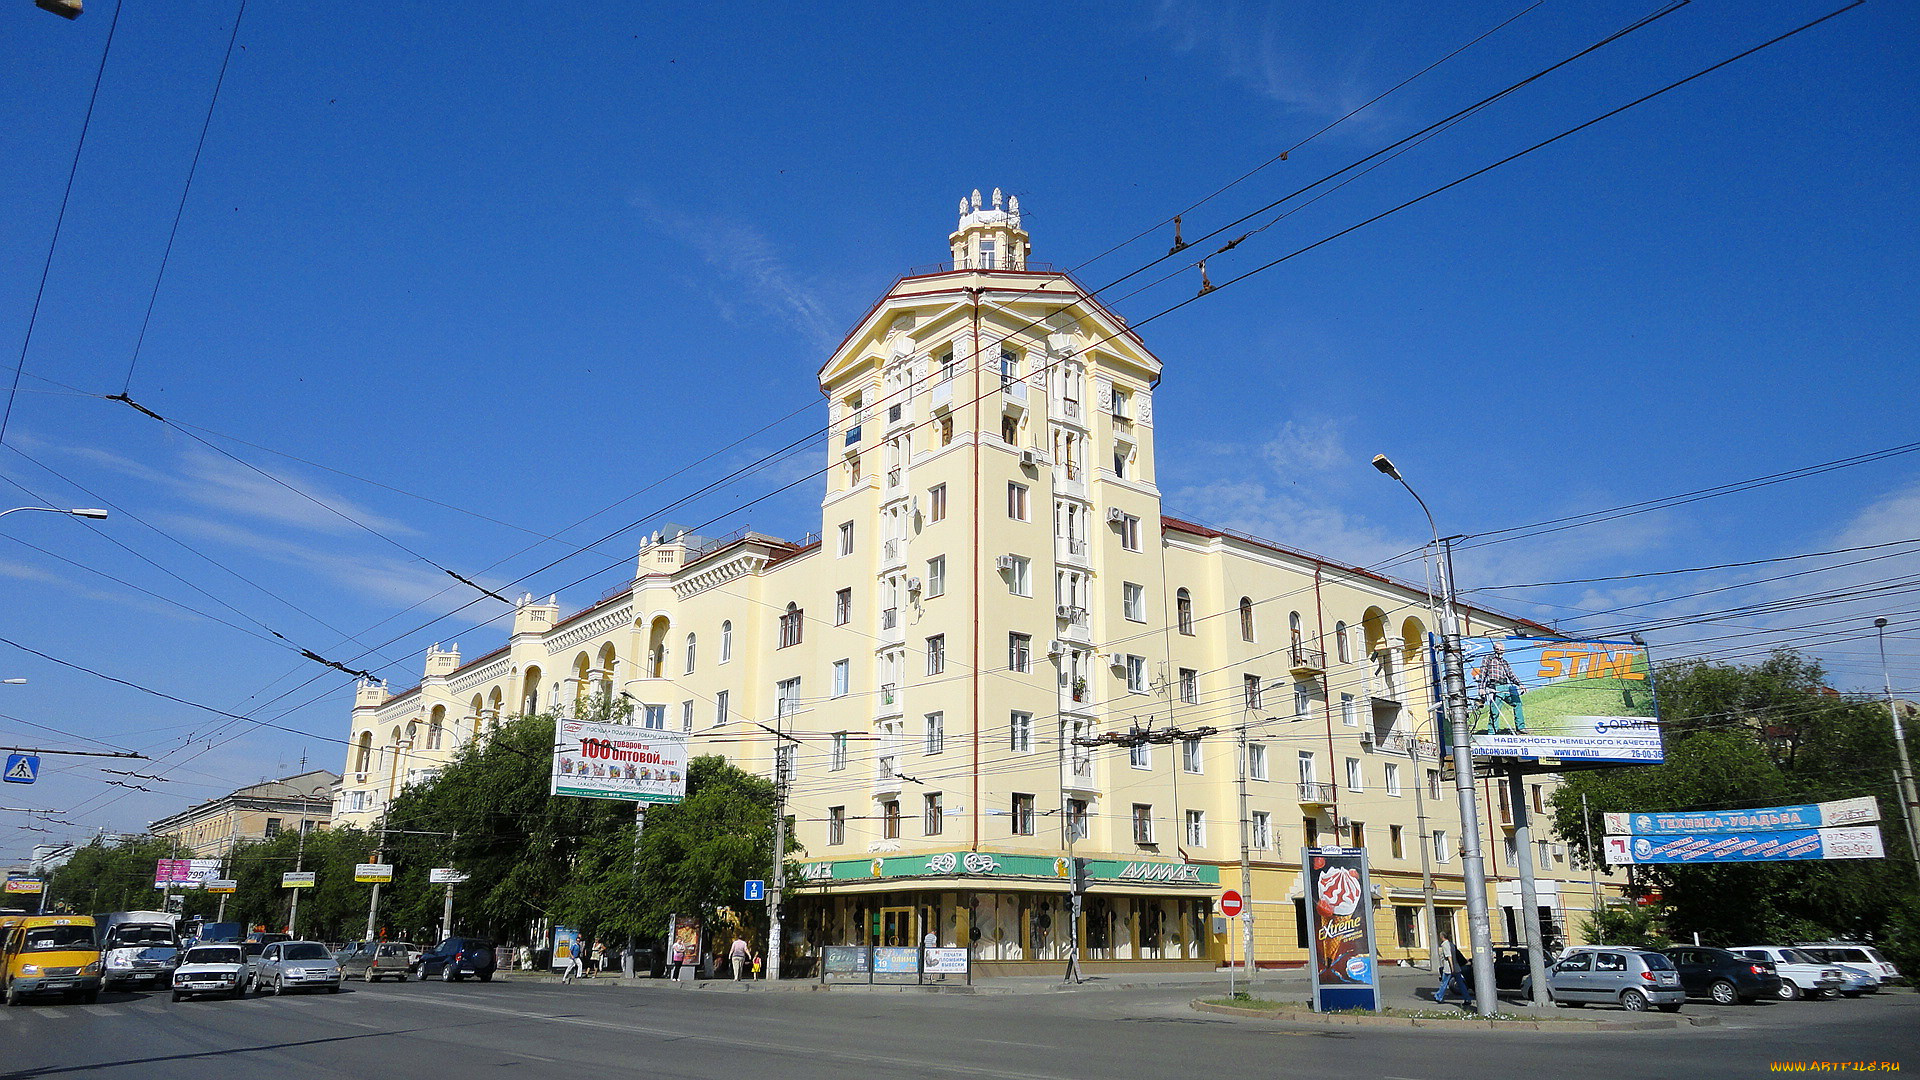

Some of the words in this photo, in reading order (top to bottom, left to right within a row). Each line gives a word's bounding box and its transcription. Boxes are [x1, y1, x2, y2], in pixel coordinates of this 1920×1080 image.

[1537, 650, 1645, 680] STIHL
[1609, 719, 1657, 731] ORWIL
[1493, 737, 1557, 745] НАДЕЖНОСТЬ
[580, 737, 610, 760] 100
[1471, 747, 1518, 756] офсоюзная
[1520, 748, 1529, 756] 18
[1554, 749, 1600, 757] www.orwil.ru
[1632, 750, 1664, 758] 26-00-36
[1658, 812, 1802, 829] ТЕХНИКА-УСАДЬБА
[1118, 861, 1201, 882] АЛМАЗ
